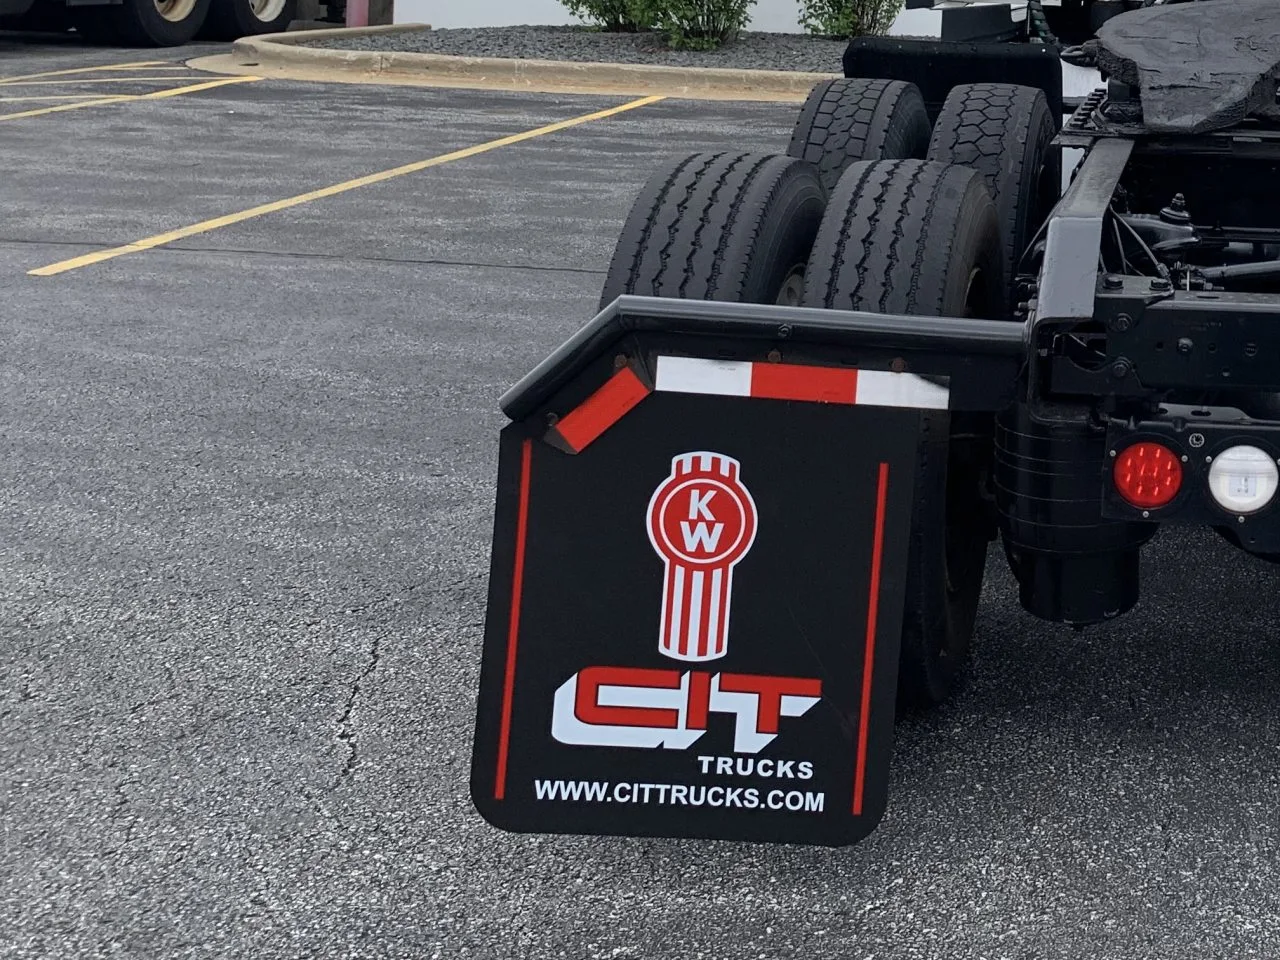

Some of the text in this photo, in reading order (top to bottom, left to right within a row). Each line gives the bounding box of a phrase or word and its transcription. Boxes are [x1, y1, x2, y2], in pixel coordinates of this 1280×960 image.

[689, 489, 718, 521] K
[680, 522, 724, 554] W
[551, 666, 822, 753] CIT
[698, 756, 814, 780] TRUCKS
[535, 780, 825, 813] WWW.CITTRUCKS.COM
